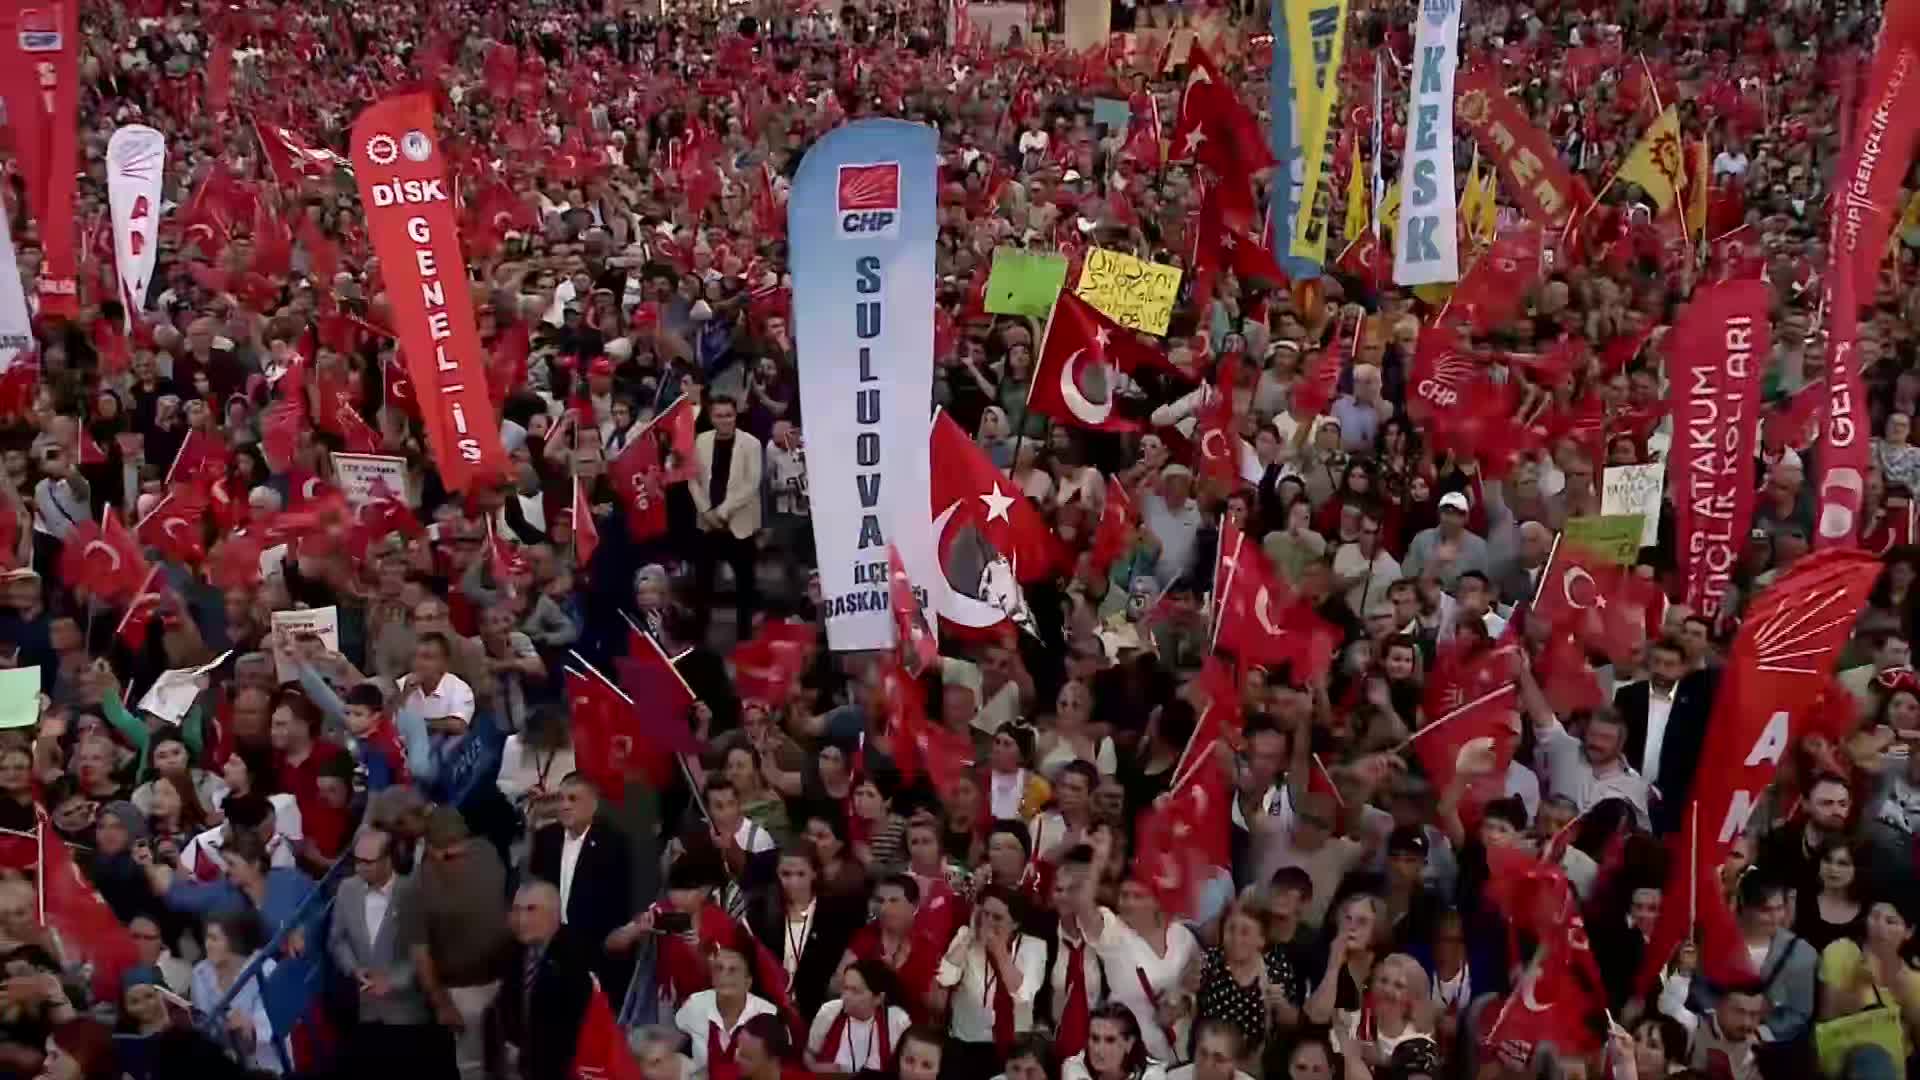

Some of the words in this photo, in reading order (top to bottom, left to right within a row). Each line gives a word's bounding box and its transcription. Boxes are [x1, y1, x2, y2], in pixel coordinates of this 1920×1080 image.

[372, 175, 448, 207] DİSK
[1406, 46, 1446, 263] KESK
[842, 212, 893, 233] CHP
[856, 256, 884, 549] SULUOVA
[1417, 379, 1457, 407] CHP
[1689, 365, 1718, 517] ATAKUM
